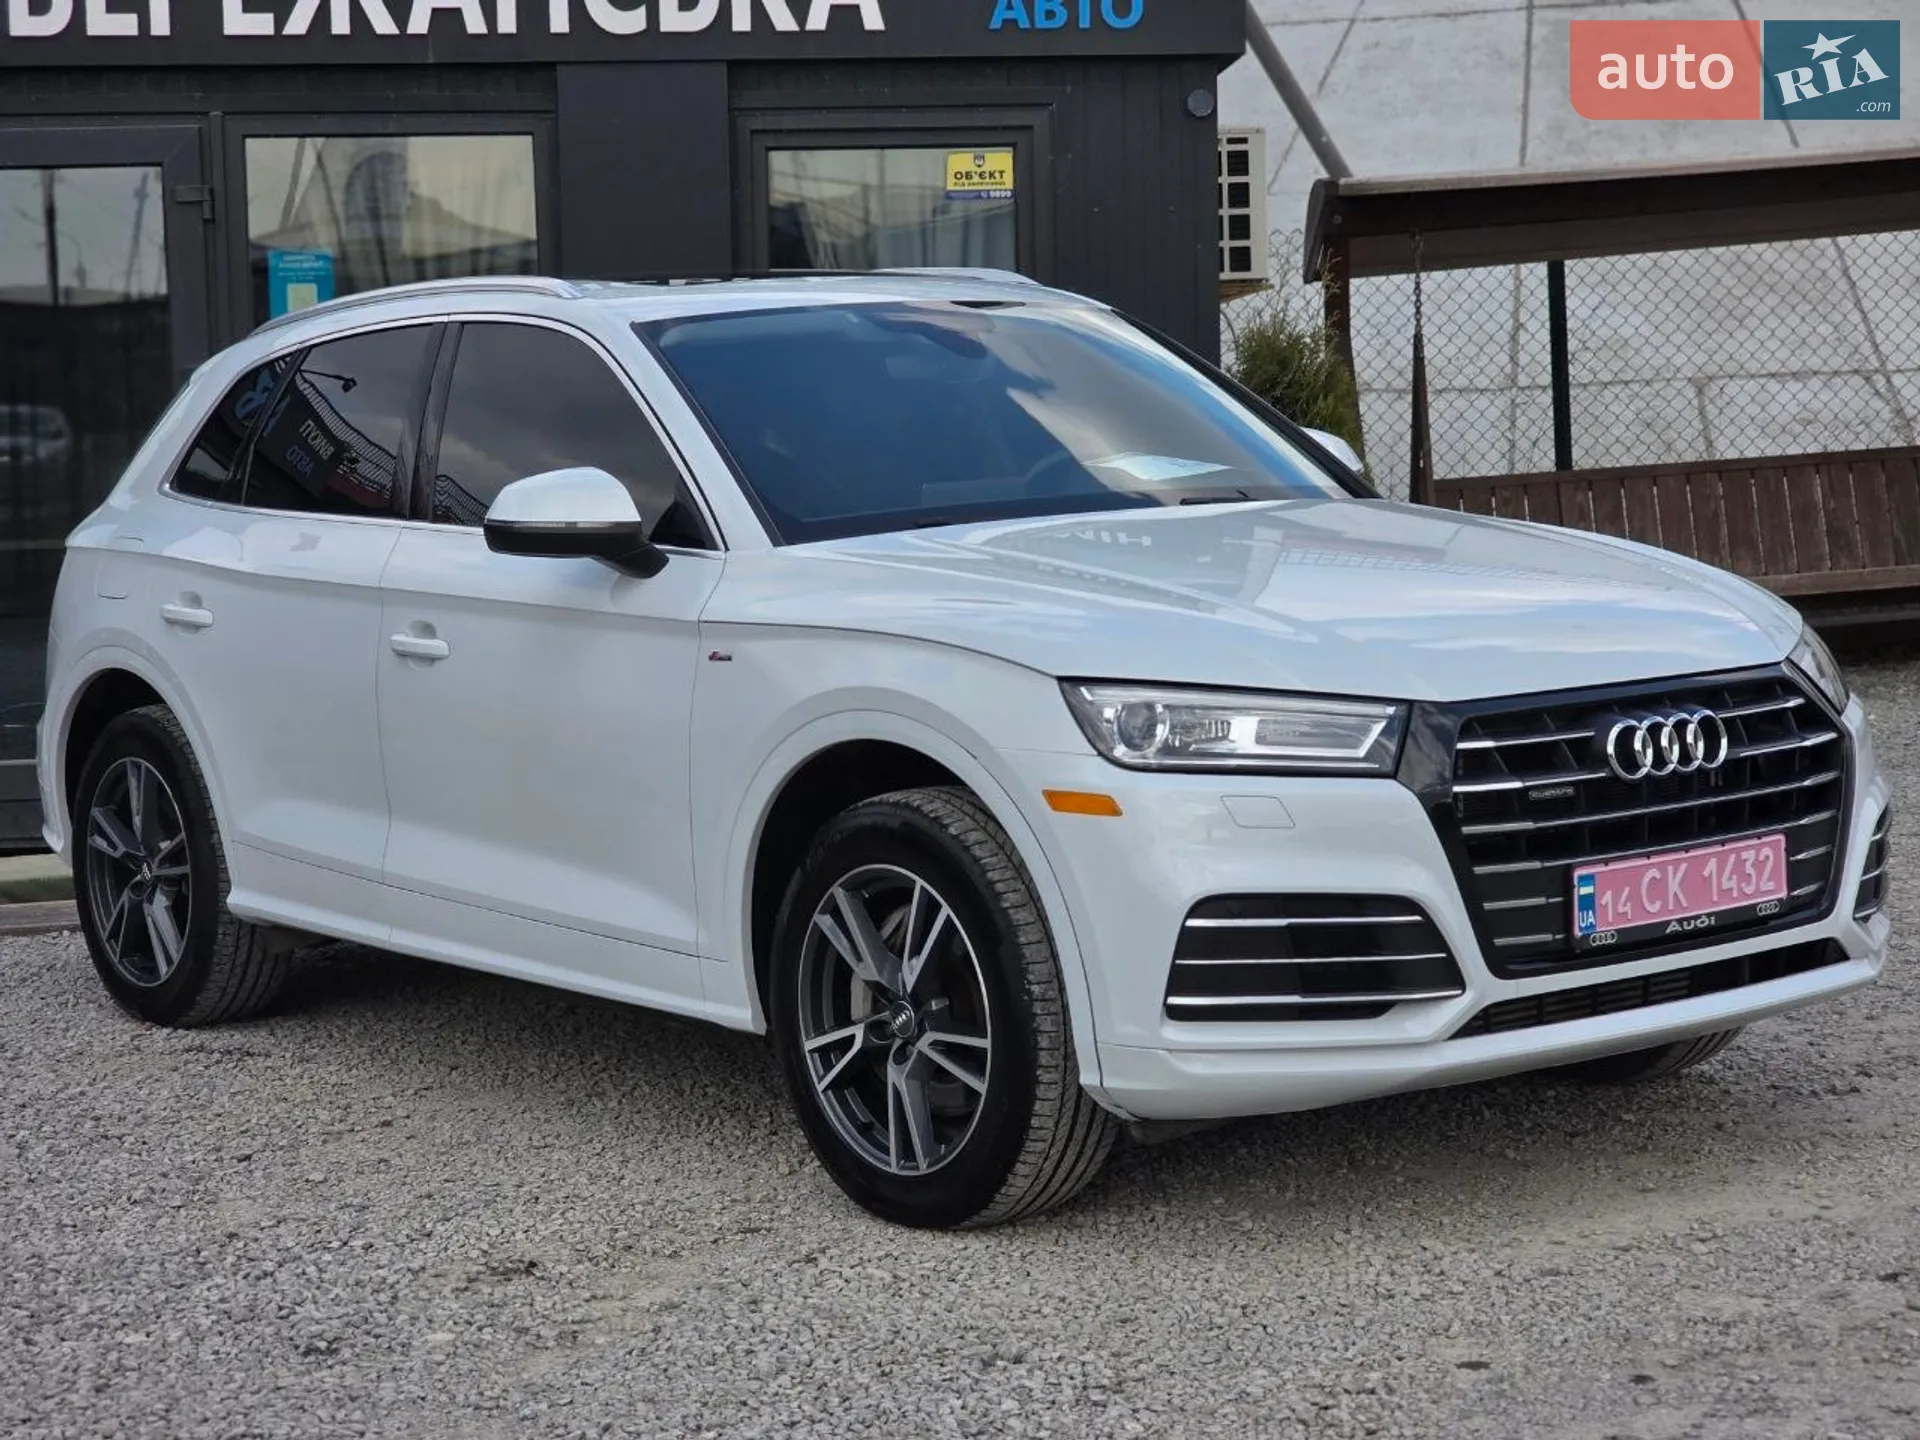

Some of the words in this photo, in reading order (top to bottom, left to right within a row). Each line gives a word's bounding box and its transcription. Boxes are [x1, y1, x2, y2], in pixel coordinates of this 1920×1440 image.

[1600, 887, 1632, 922] 14
[1640, 862, 1689, 914] CK
[1703, 847, 1776, 902] 1432
[1579, 910, 1596, 928] UA
[1665, 916, 1716, 934] Audi
